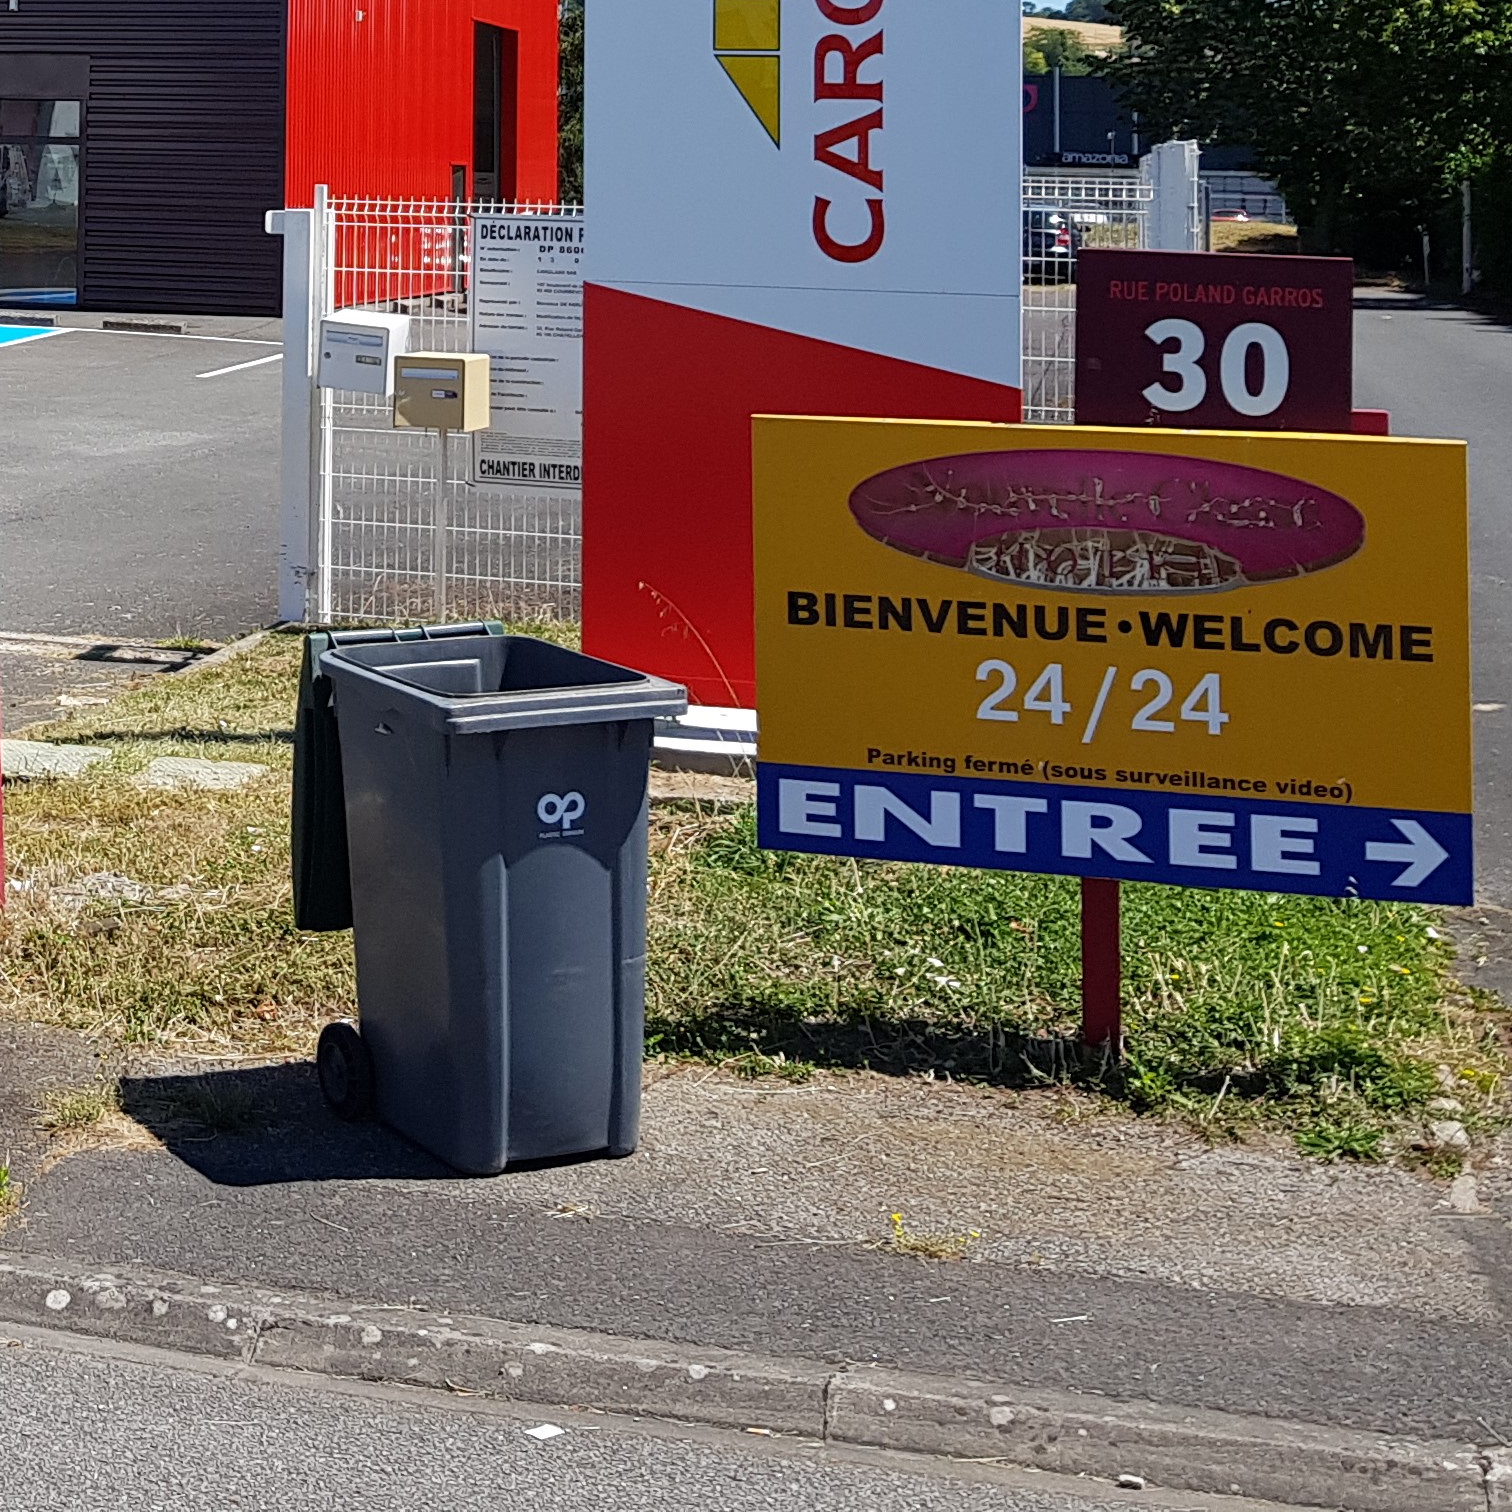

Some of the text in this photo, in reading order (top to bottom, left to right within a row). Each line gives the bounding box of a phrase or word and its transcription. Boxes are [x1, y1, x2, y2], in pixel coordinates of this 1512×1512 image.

[480, 221, 574, 243] DÉCLARATION
[1109, 280, 1149, 301] RUE
[1242, 286, 1324, 309] GARROS
[1141, 318, 1289, 417] 30
[479, 459, 583, 482] CHANTIER INTERD
[975, 659, 1230, 744] 24/24
[866, 748, 1354, 804] Parking fermé (sous surveillance video)
[779, 778, 1320, 876] ENTREE
